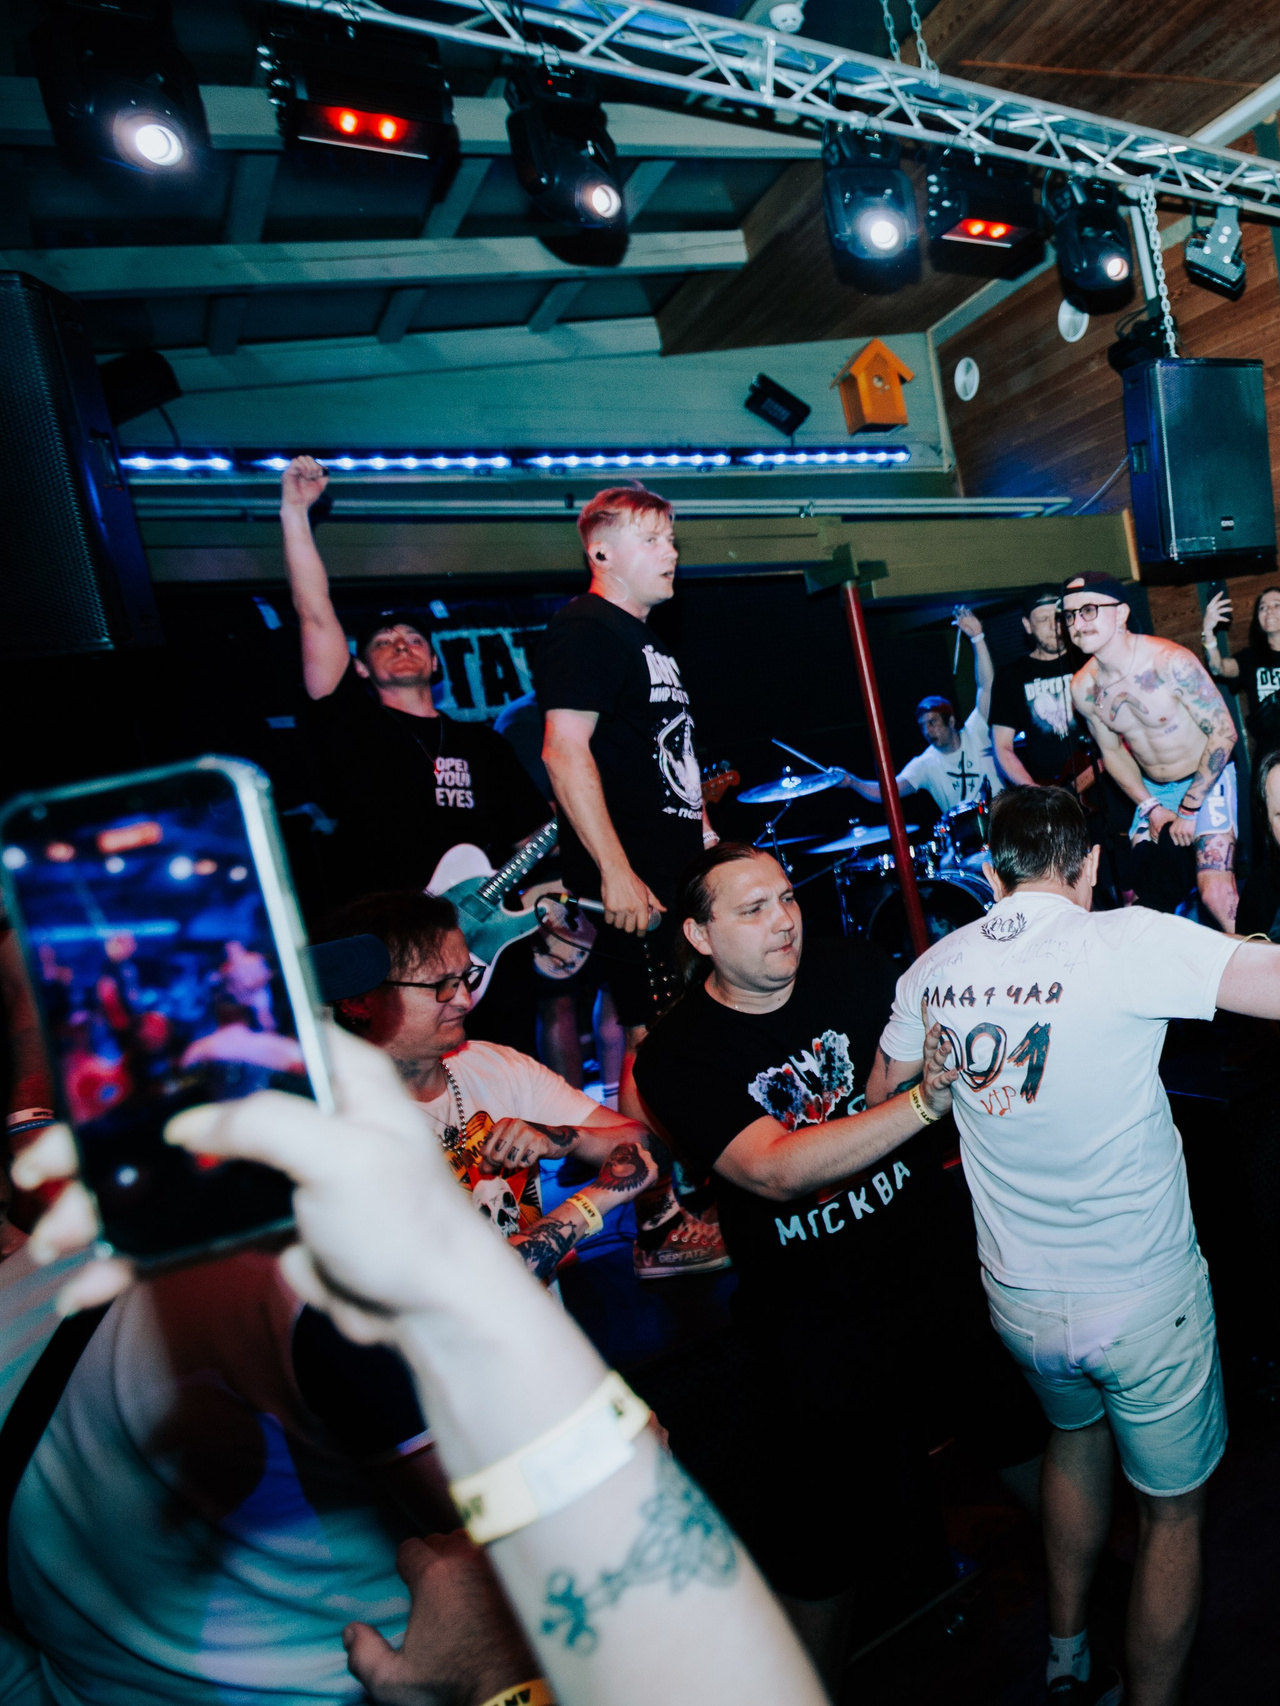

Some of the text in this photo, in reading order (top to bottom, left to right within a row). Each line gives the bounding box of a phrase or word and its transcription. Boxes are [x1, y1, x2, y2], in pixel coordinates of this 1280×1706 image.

[435, 787, 474, 808] EYES
[1207, 783, 1227, 827] FILA
[980, 1085, 1017, 1116] VIP
